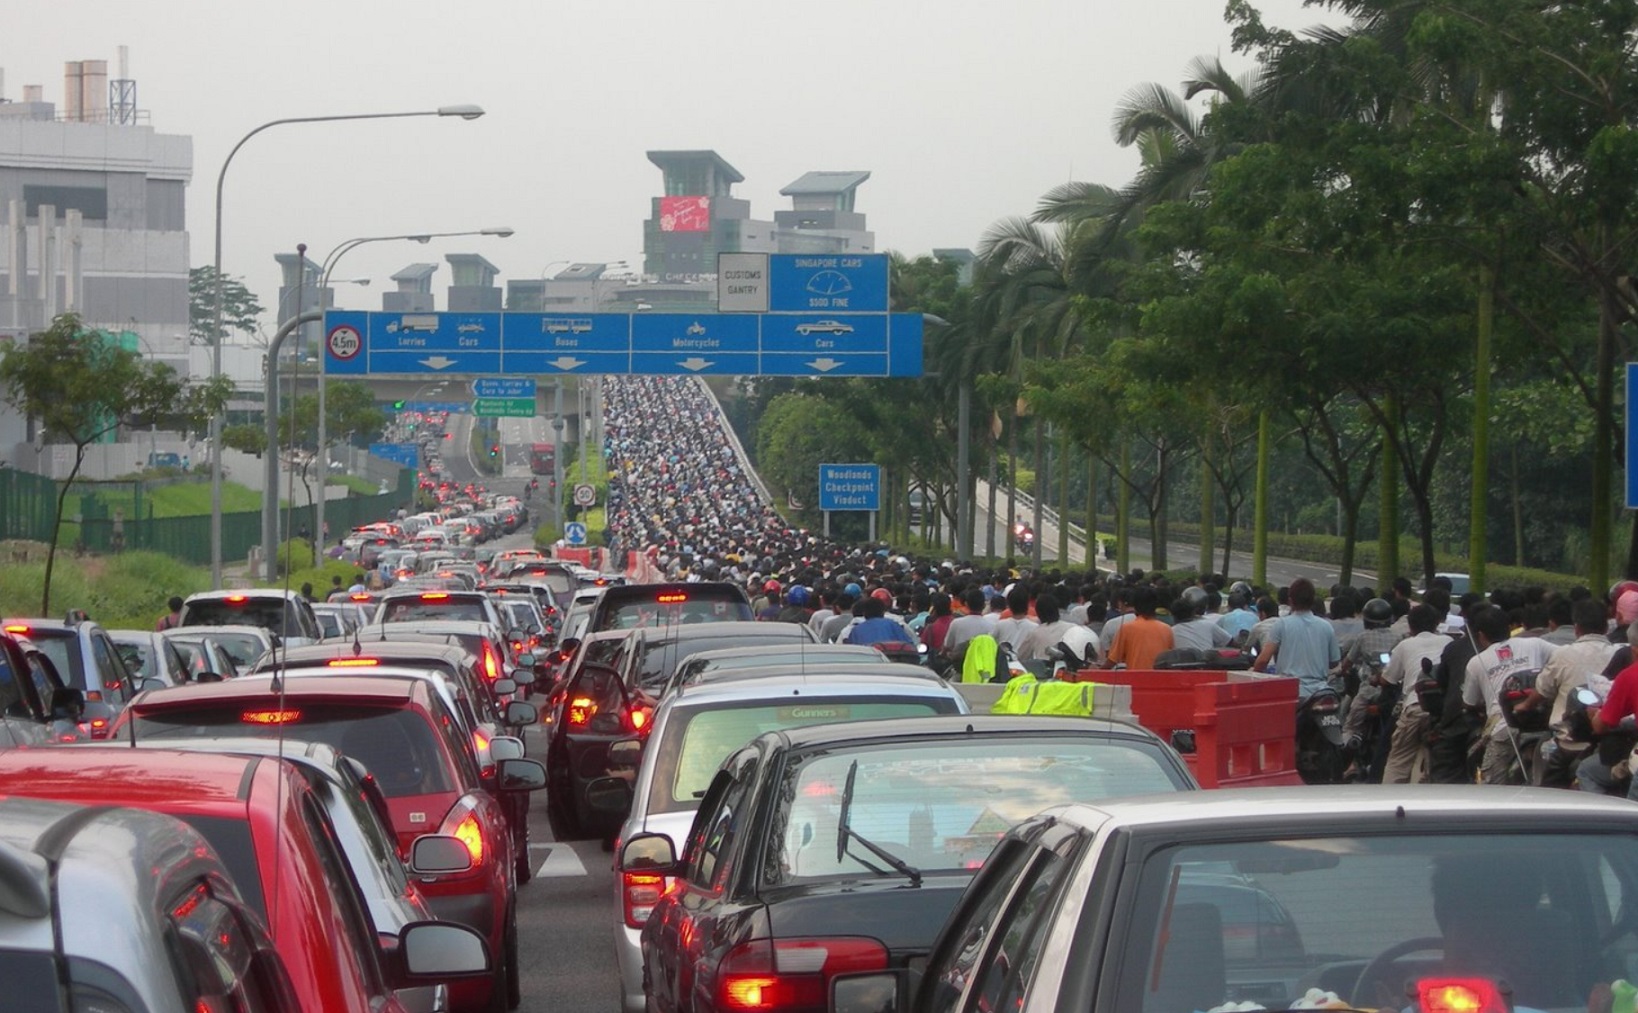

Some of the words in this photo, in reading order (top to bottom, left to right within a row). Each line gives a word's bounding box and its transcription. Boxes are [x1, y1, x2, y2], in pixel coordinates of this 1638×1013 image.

[795, 258, 837, 268] SINGAPORE
[841, 258, 862, 268] CARS
[725, 270, 761, 280] CUSTOMS
[728, 285, 758, 295] GANTRY
[832, 297, 849, 308] FINE
[332, 336, 356, 348] 4.5m
[398, 336, 426, 346] Lorries
[459, 336, 478, 346] Cars
[555, 336, 578, 346] Buses
[673, 337, 720, 348] Motorcycles
[815, 338, 834, 348] Cars
[827, 469, 872, 479] Woodlands
[825, 482, 874, 494] Checkpoint
[833, 495, 867, 504] Viaduct
[791, 707, 837, 718] Gunners
